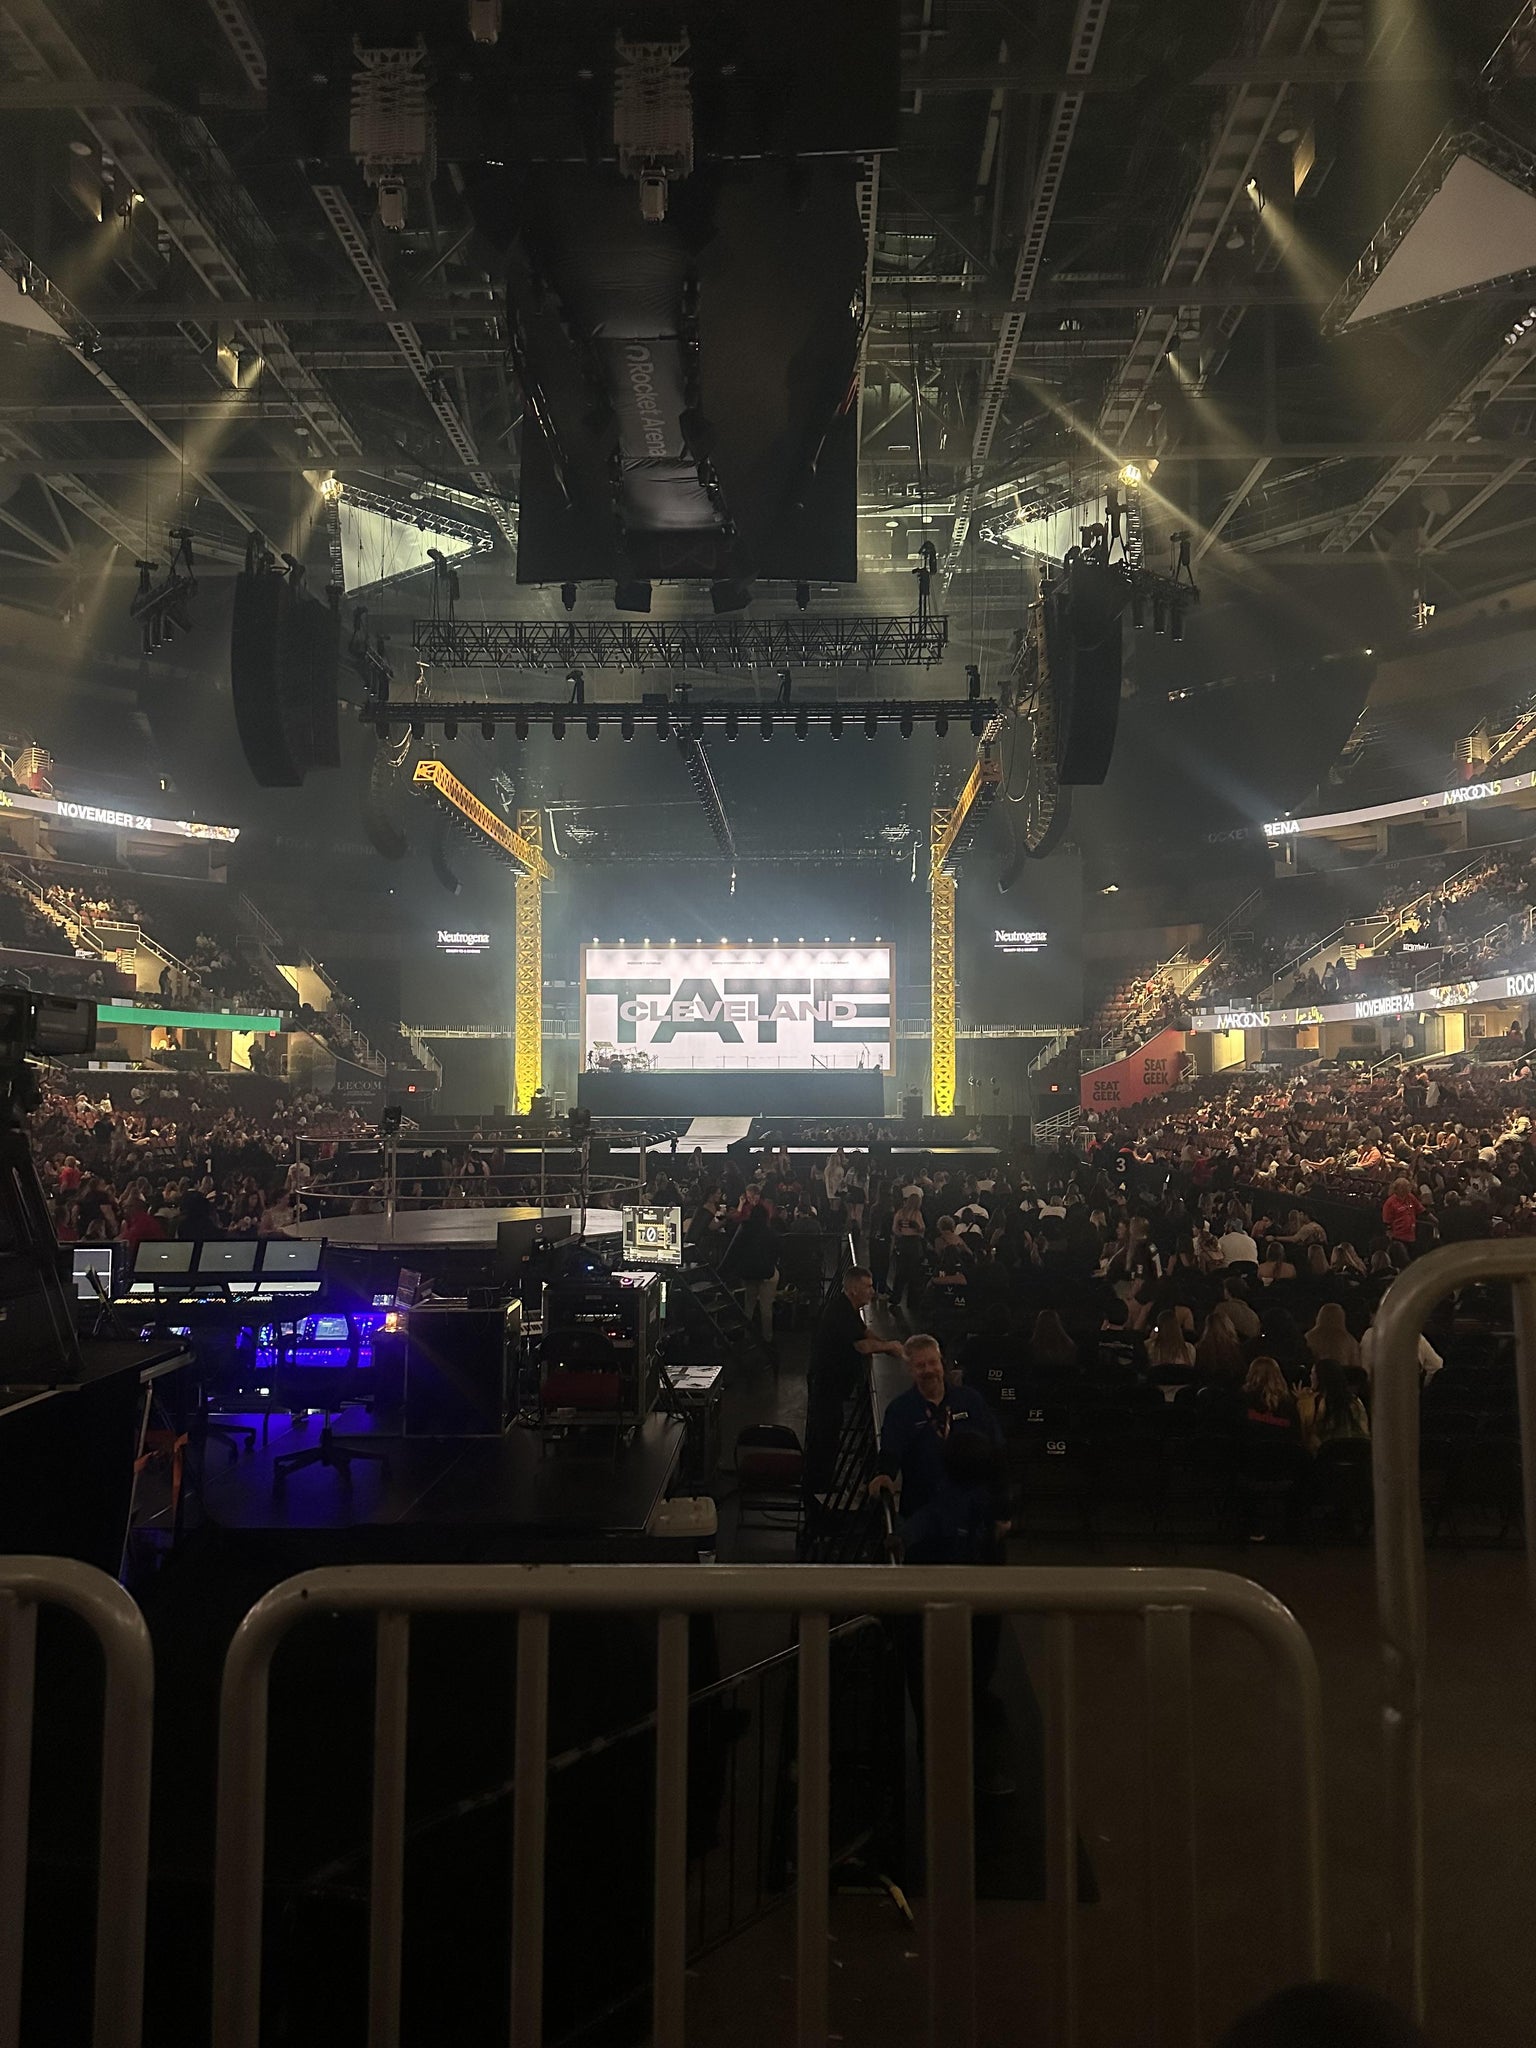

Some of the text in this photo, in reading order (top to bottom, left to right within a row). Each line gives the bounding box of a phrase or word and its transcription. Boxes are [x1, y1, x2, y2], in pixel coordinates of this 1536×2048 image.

[627, 362, 667, 457] Rocket Arena
[57, 801, 152, 830] NOVEMBER 24
[437, 930, 490, 945] Neutrogena
[994, 930, 1048, 944] Neutrogena
[1506, 972, 1536, 996] ROC
[586, 978, 890, 1043] TATE
[619, 1000, 857, 1022] CLEVELAND
[1355, 993, 1415, 1018] NOVEMBER 24
[1144, 1058, 1167, 1071] SEAT
[1143, 1072, 1169, 1085] GEEK
[336, 1081, 382, 1090] LECOM
[1094, 1081, 1119, 1091] SEAT
[1092, 1091, 1120, 1101] GEEK
[987, 1369, 1003, 1378] DD
[1000, 1387, 1016, 1397] EE
[1028, 1409, 1044, 1418] FF
[1046, 1440, 1067, 1451] GG
